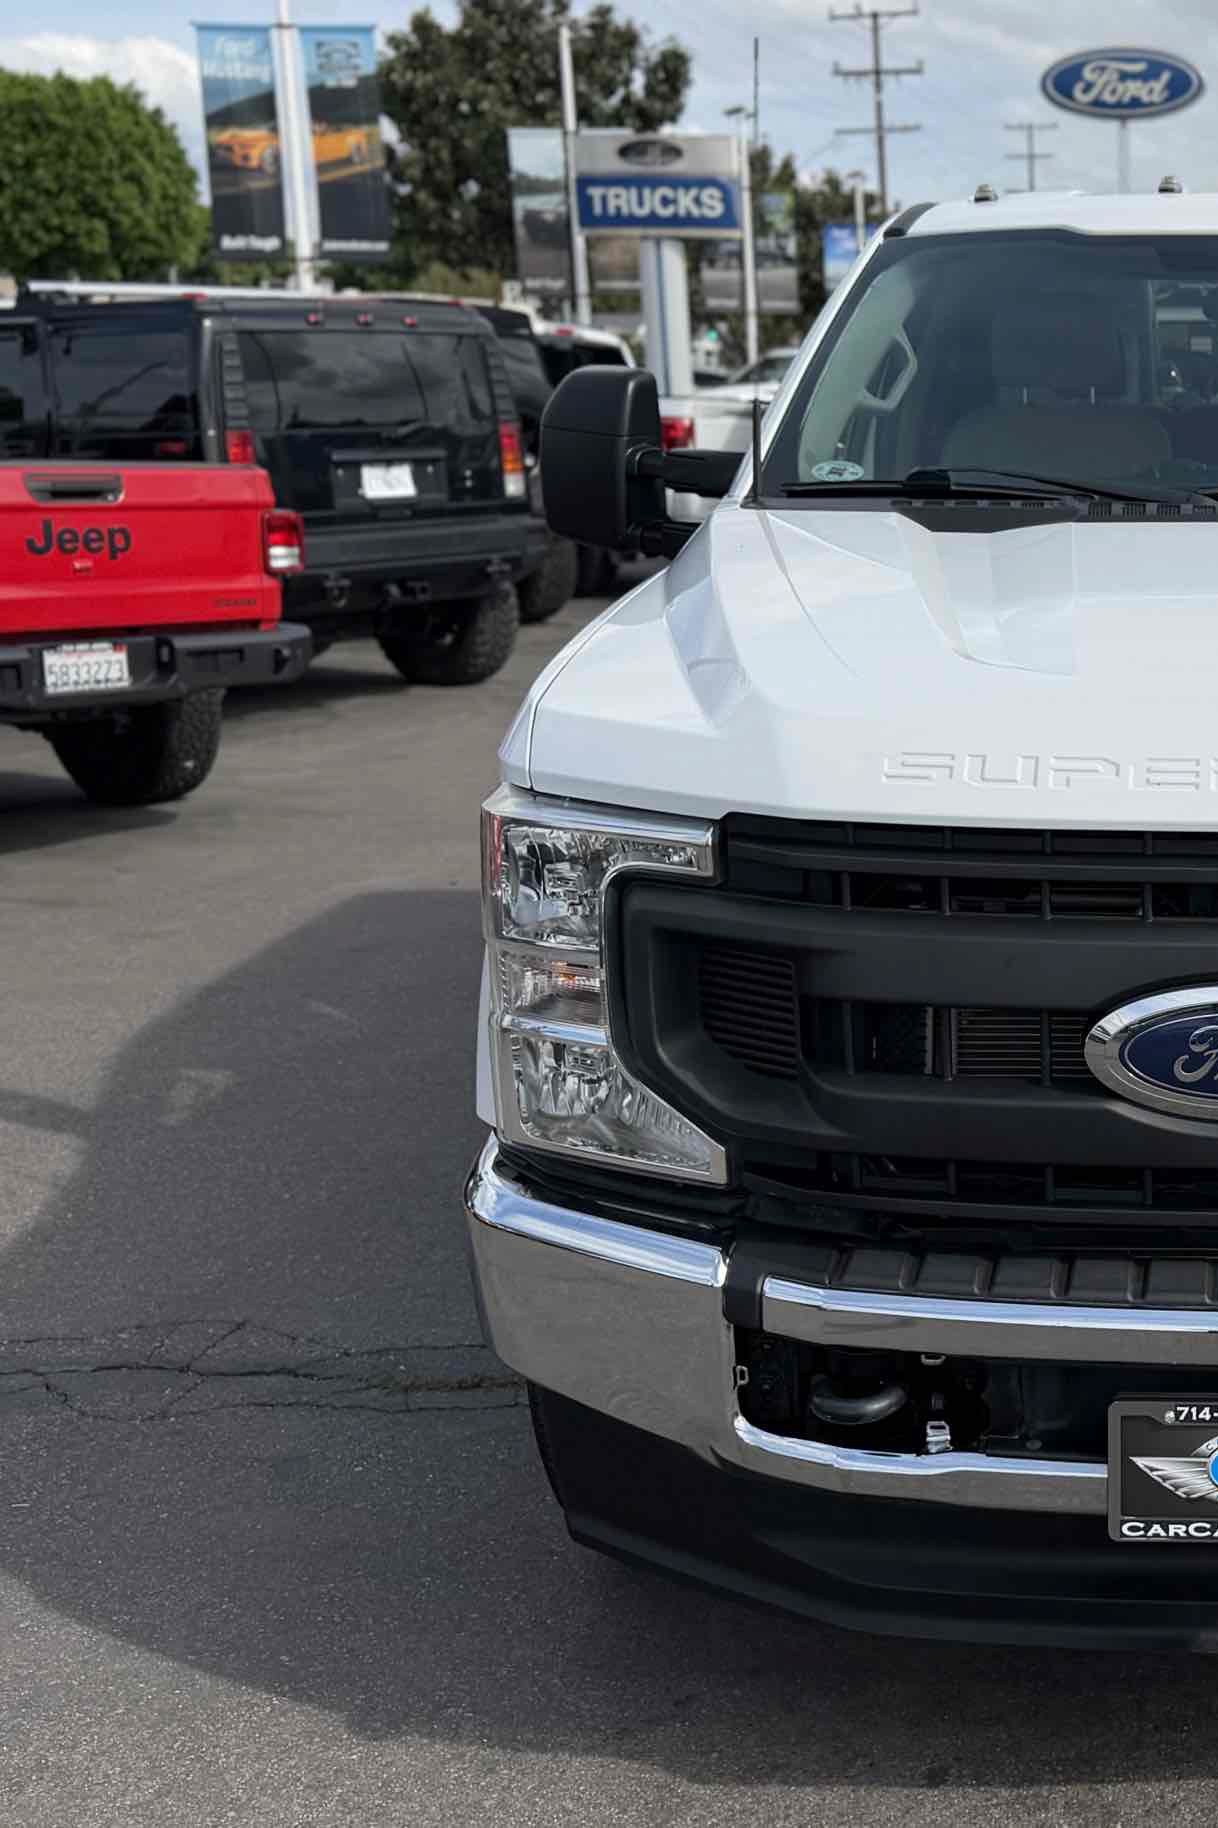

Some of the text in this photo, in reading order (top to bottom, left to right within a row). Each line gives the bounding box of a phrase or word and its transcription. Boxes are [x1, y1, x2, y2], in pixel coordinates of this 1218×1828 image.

[1072, 59, 1171, 104] Ford
[586, 185, 725, 220] TRUCKS
[25, 519, 132, 560] Jeep
